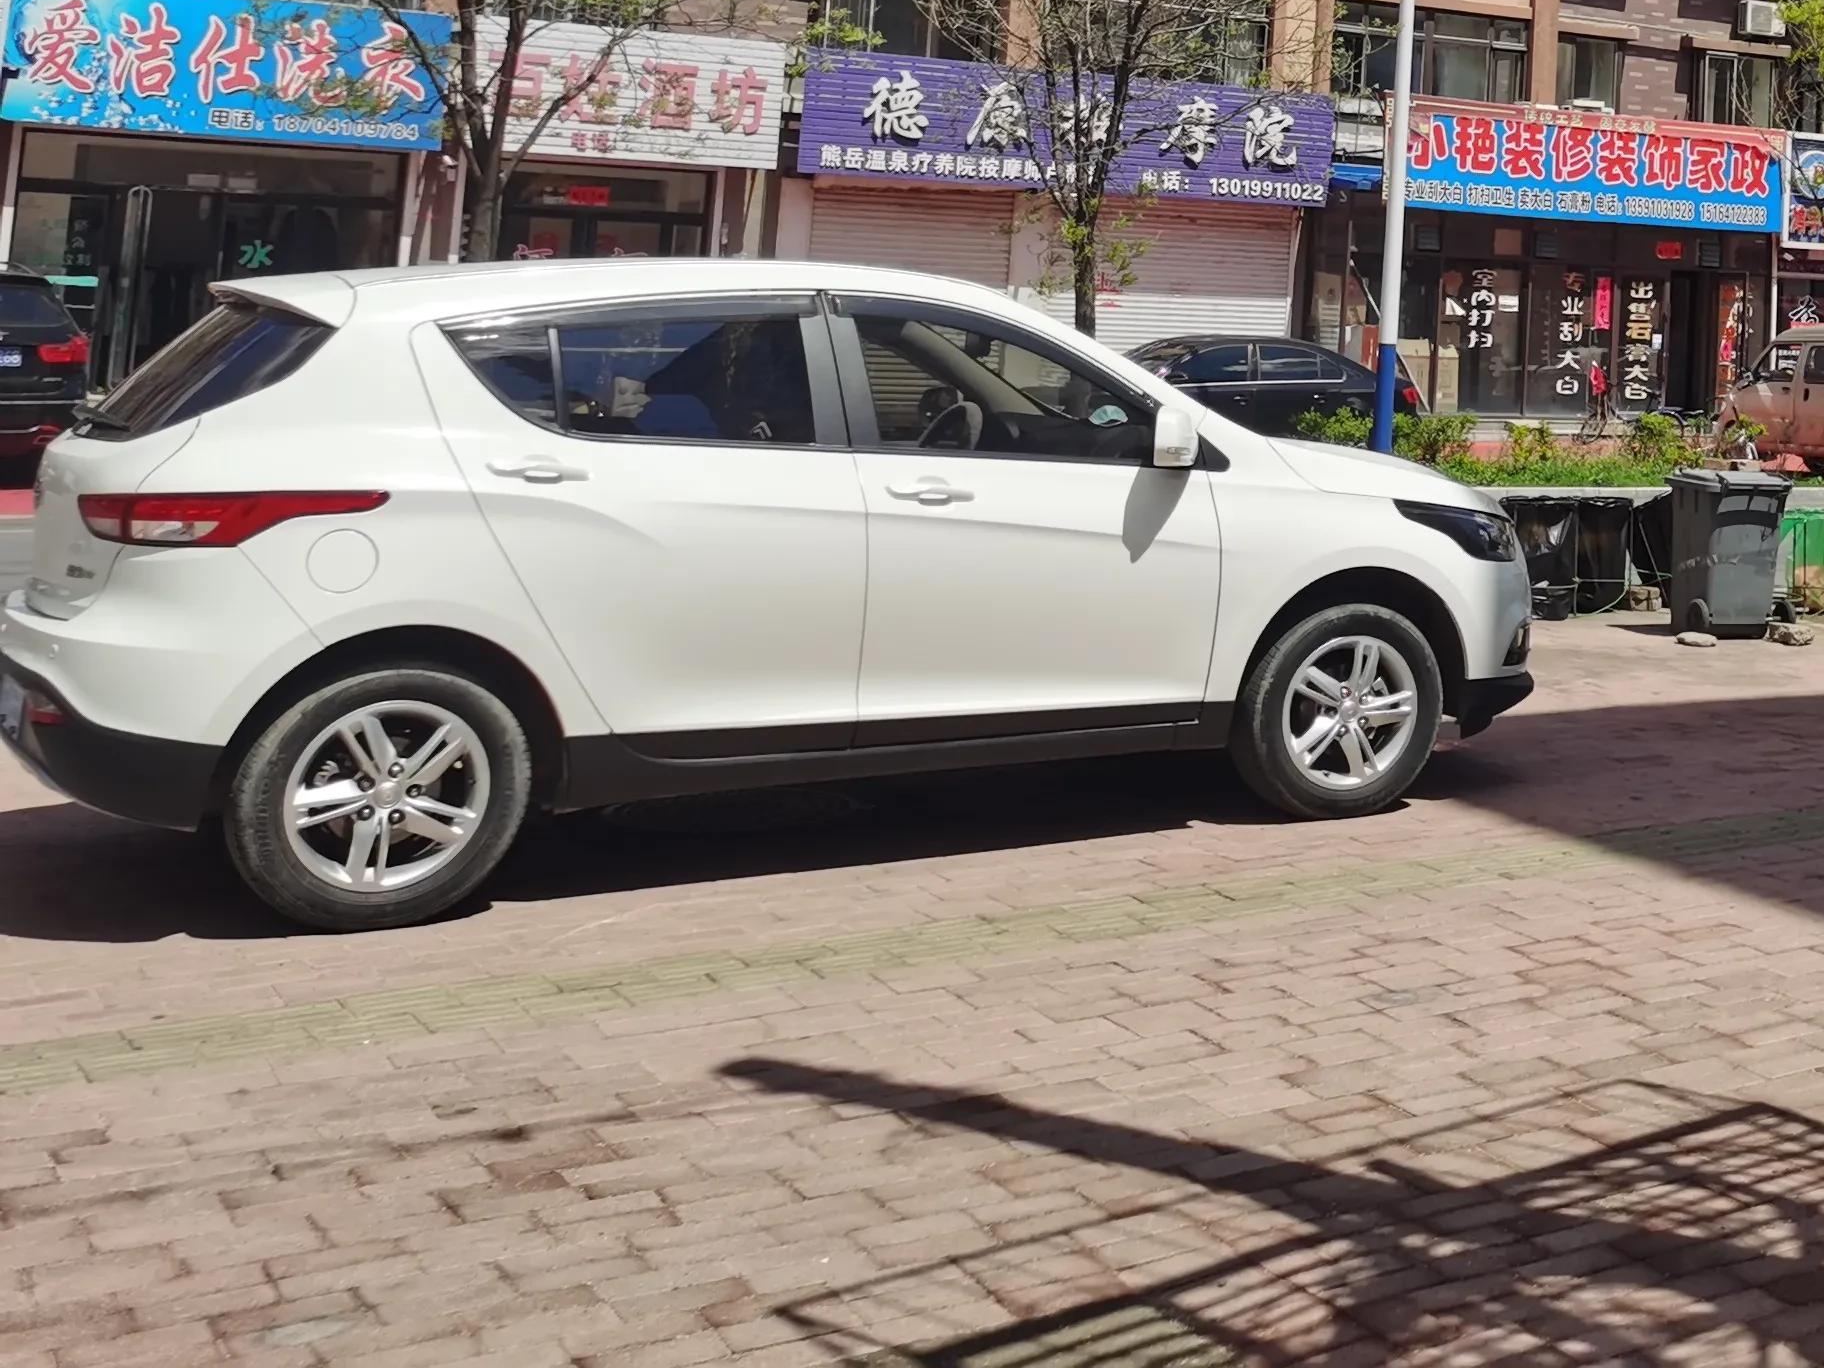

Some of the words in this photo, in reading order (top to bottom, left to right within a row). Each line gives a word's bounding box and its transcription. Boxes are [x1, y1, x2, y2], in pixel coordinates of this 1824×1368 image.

[1406, 116, 1769, 197] 小艳装修装饰家政
[1209, 178, 1325, 202] 13019911022
[1404, 179, 1463, 205] 专业刮大白
[1467, 182, 1515, 208] 打扫卫生
[1518, 187, 1554, 211] 卖大白
[1557, 191, 1592, 214] 石膏粉
[1700, 201, 1767, 226] 15164122383
